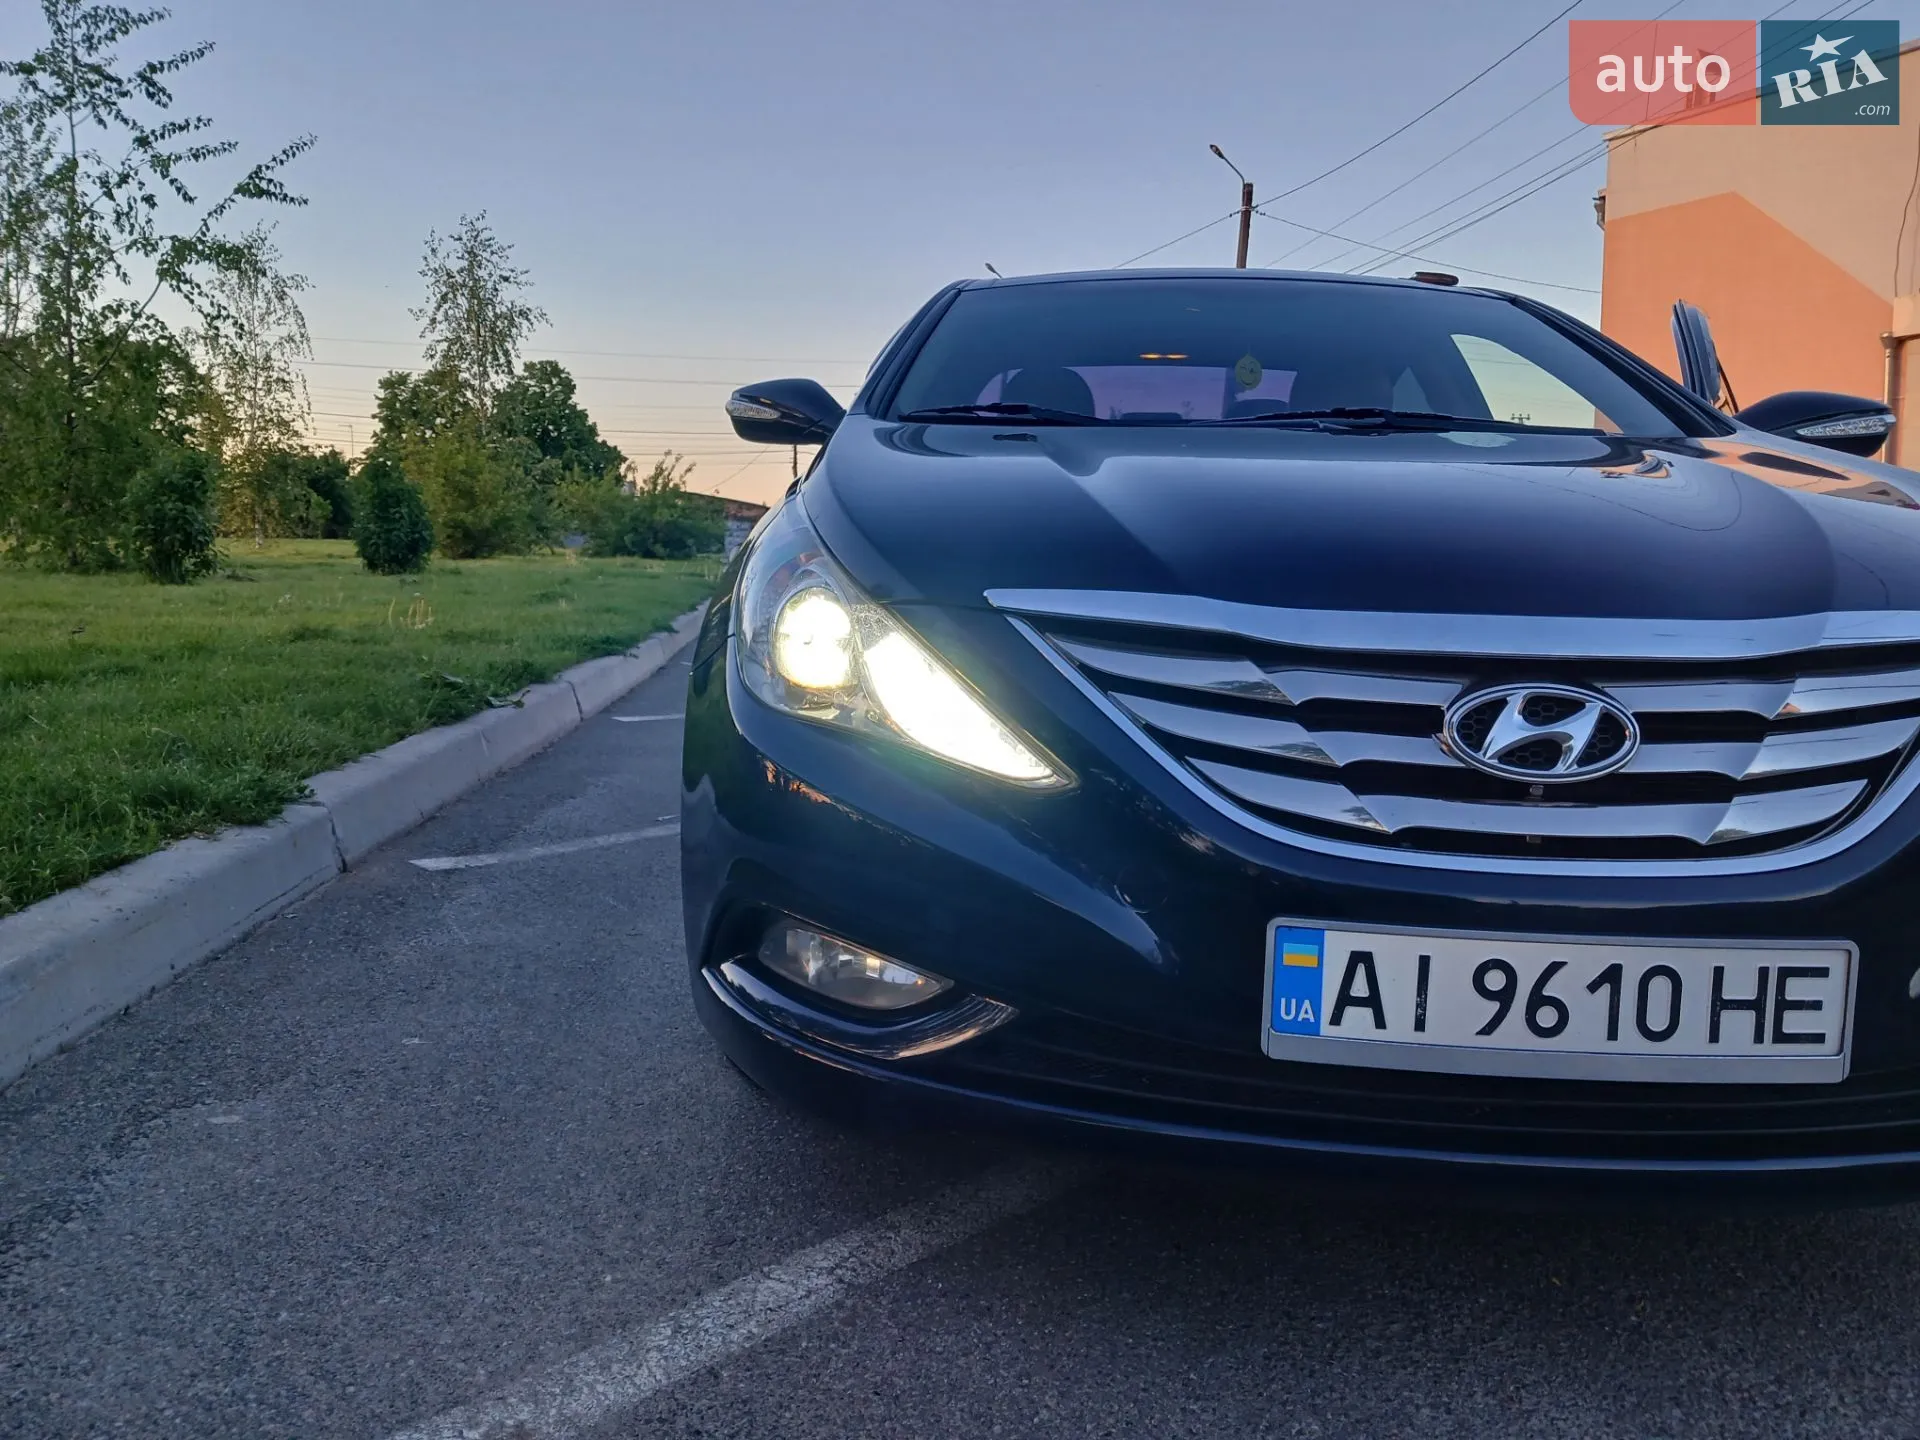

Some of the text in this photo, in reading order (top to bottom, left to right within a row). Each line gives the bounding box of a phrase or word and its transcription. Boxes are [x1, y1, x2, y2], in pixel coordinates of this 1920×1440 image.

[1279, 998, 1316, 1024] UA
[1329, 951, 1831, 1045] AI 9610 HE
